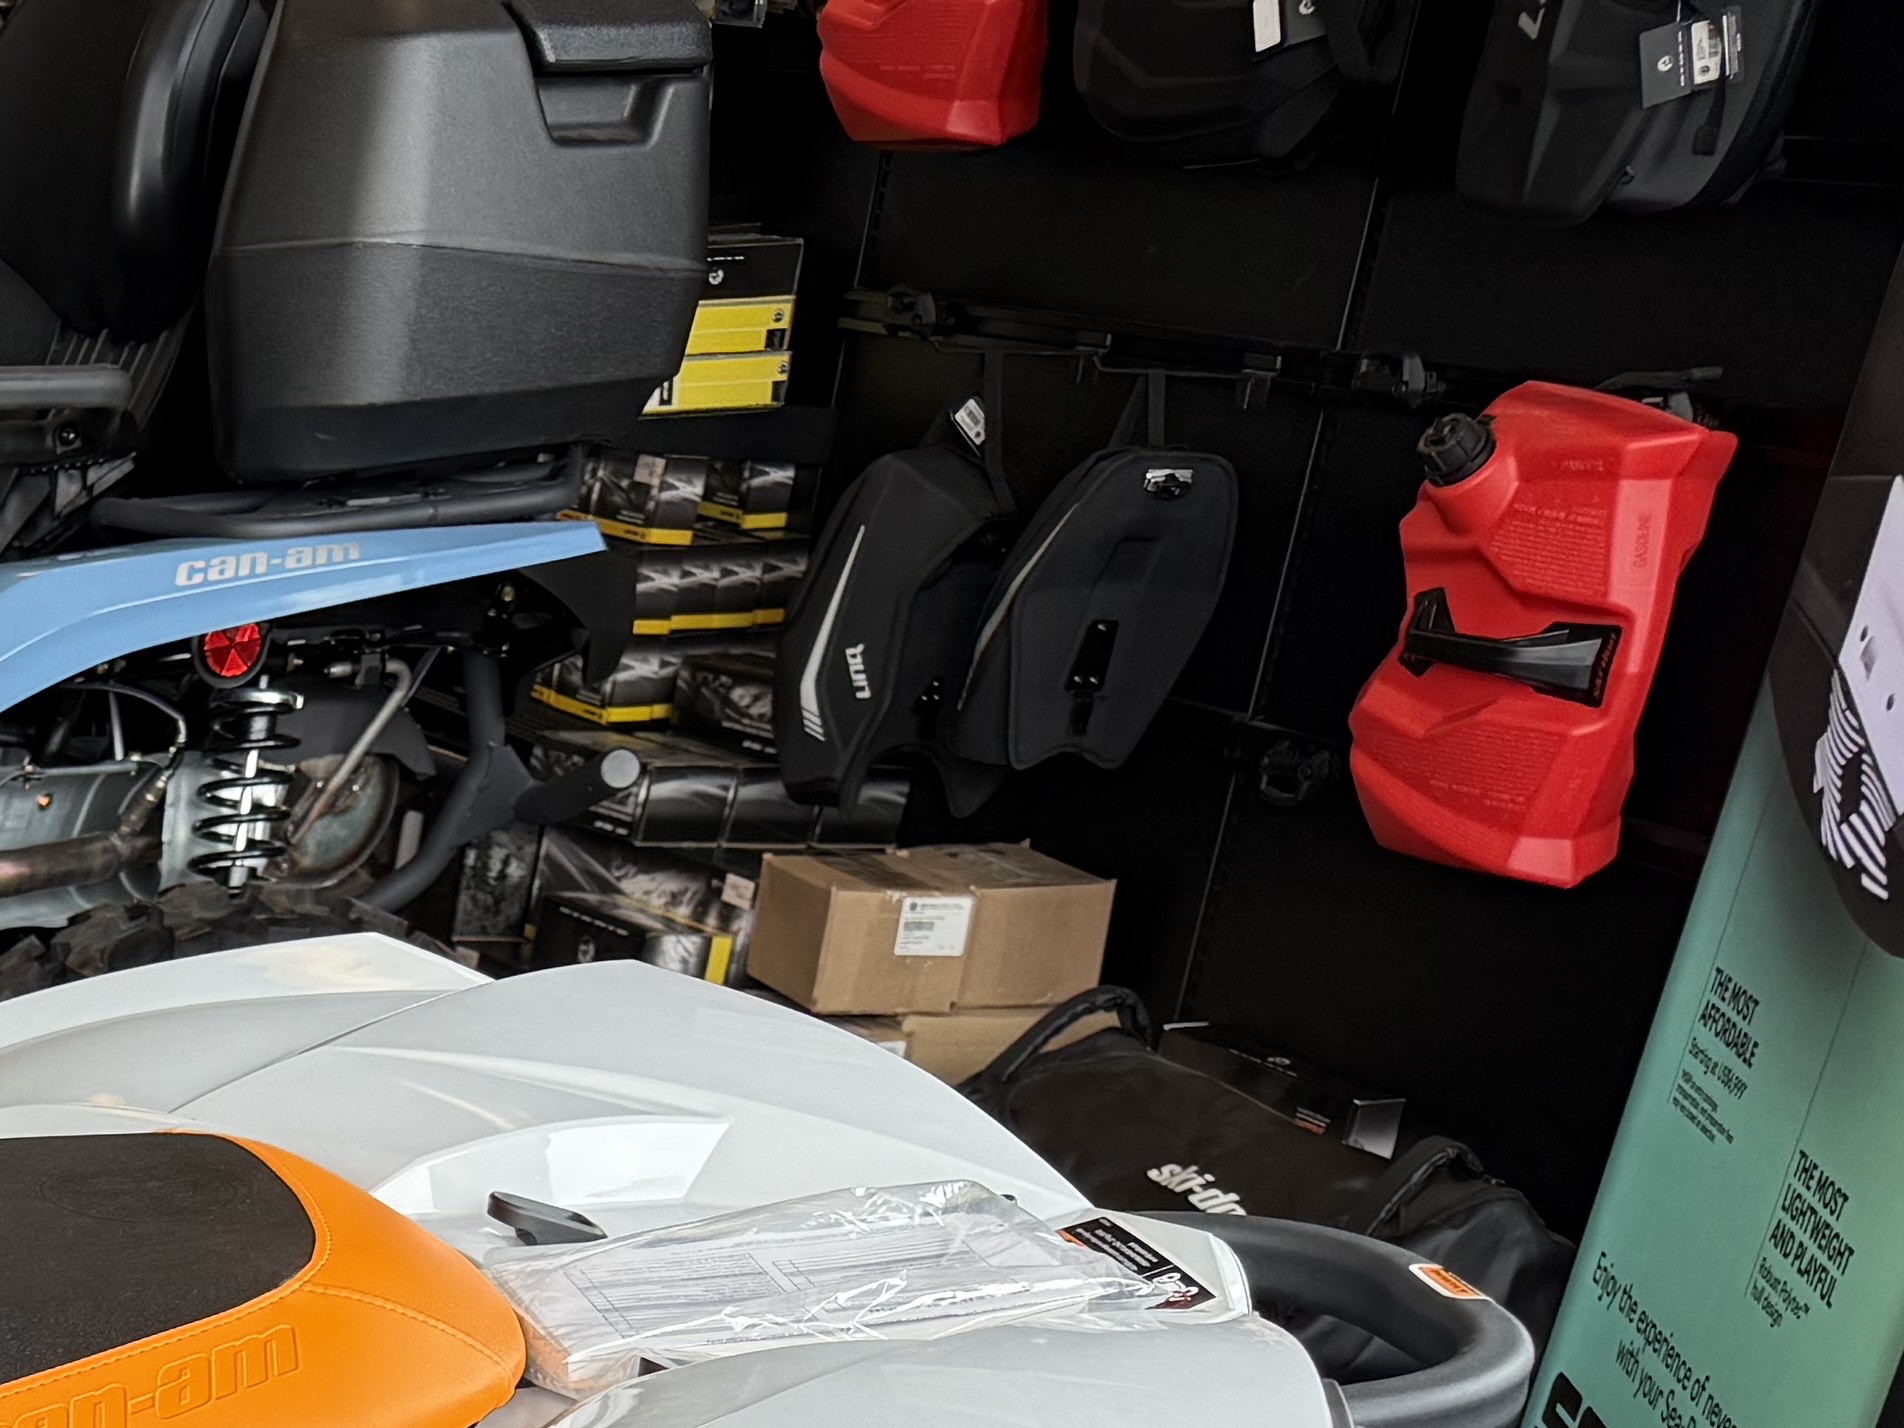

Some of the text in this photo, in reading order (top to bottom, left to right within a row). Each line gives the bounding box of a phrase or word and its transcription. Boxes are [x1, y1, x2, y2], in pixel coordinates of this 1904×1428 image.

[175, 541, 361, 588] can-am
[1710, 967, 1760, 1026] THE MOST
[1698, 1001, 1760, 1069] AFFORDABLE
[1793, 1150, 1849, 1222] THE MOST
[1769, 1218, 1838, 1308] AND PLAYFUL
[1781, 1184, 1855, 1276] LIGHTWEIGHT
[1592, 1251, 1622, 1302] Enjoy
[1618, 1283, 1638, 1324] the
[1636, 1306, 1693, 1389] experience
[1692, 1371, 1709, 1400] of
[1616, 1340, 1641, 1385] with
[1632, 1370, 1662, 1414] your
